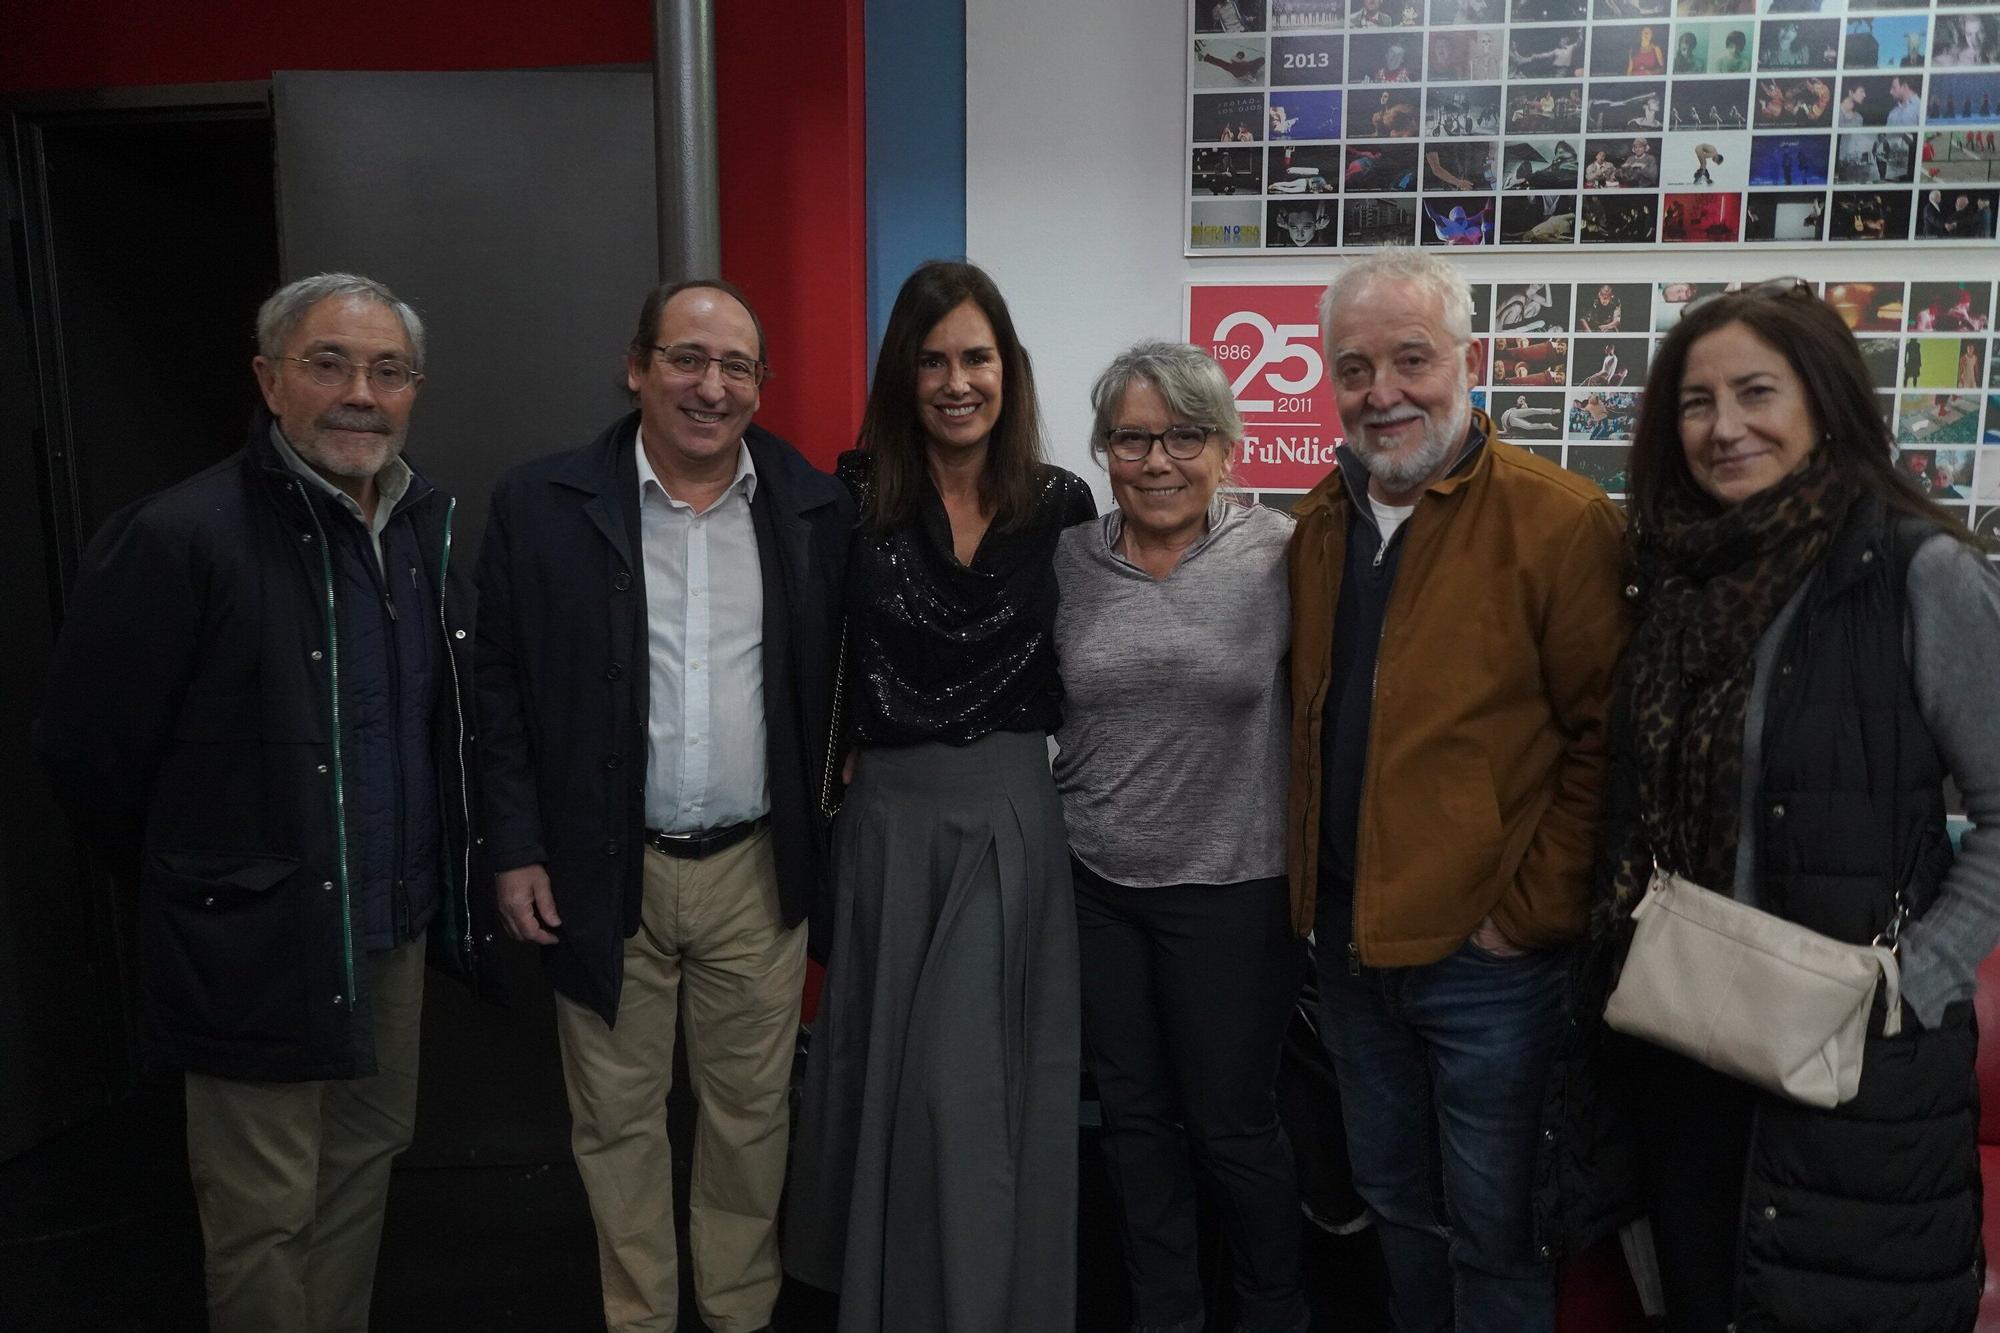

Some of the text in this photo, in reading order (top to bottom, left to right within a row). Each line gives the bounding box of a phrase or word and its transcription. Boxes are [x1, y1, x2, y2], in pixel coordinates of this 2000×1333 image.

[1283, 53, 1329, 68] 2013
[1212, 344, 1251, 360] 1986
[1212, 311, 1324, 413] 25
[1278, 397, 1312, 413] 2011
